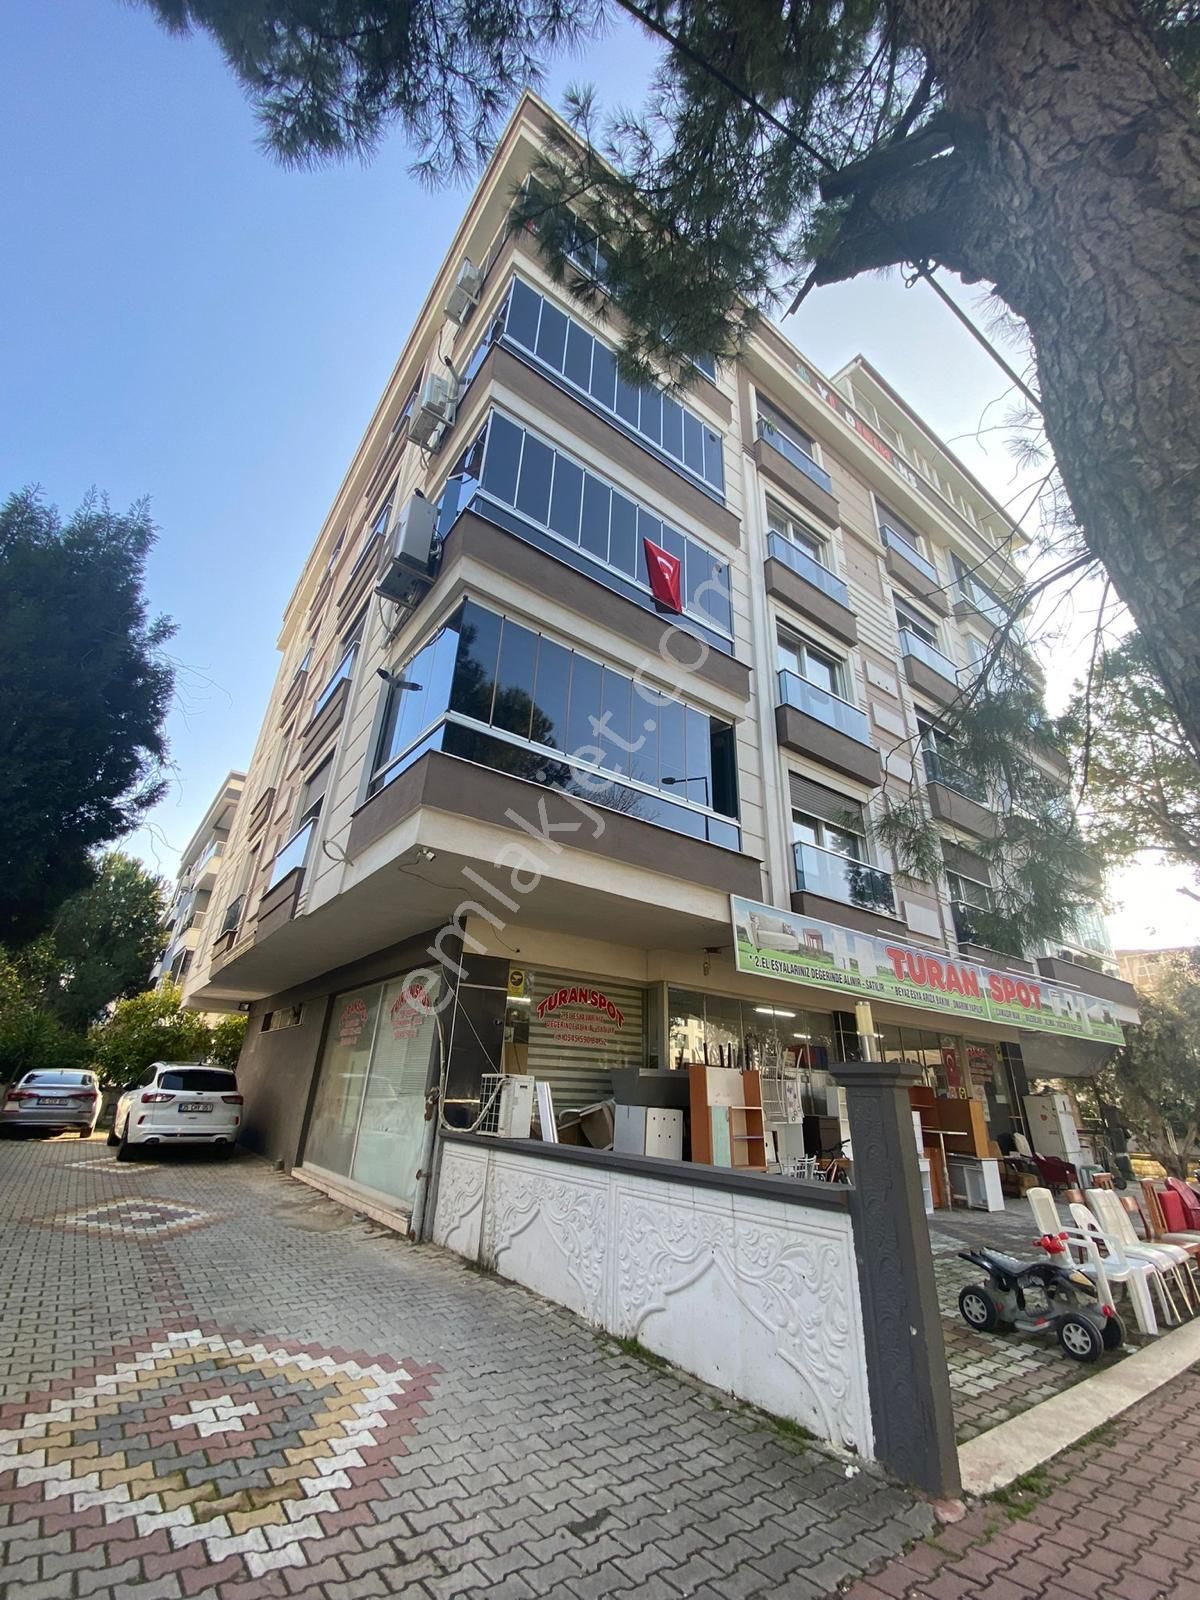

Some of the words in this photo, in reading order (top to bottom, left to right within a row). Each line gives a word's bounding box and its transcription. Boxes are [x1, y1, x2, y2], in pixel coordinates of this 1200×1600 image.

[887, 947, 980, 998] TURAN
[989, 974, 1041, 1009] SPOT
[537, 987, 588, 1020] TURAN
[590, 989, 624, 1031] SPOT
